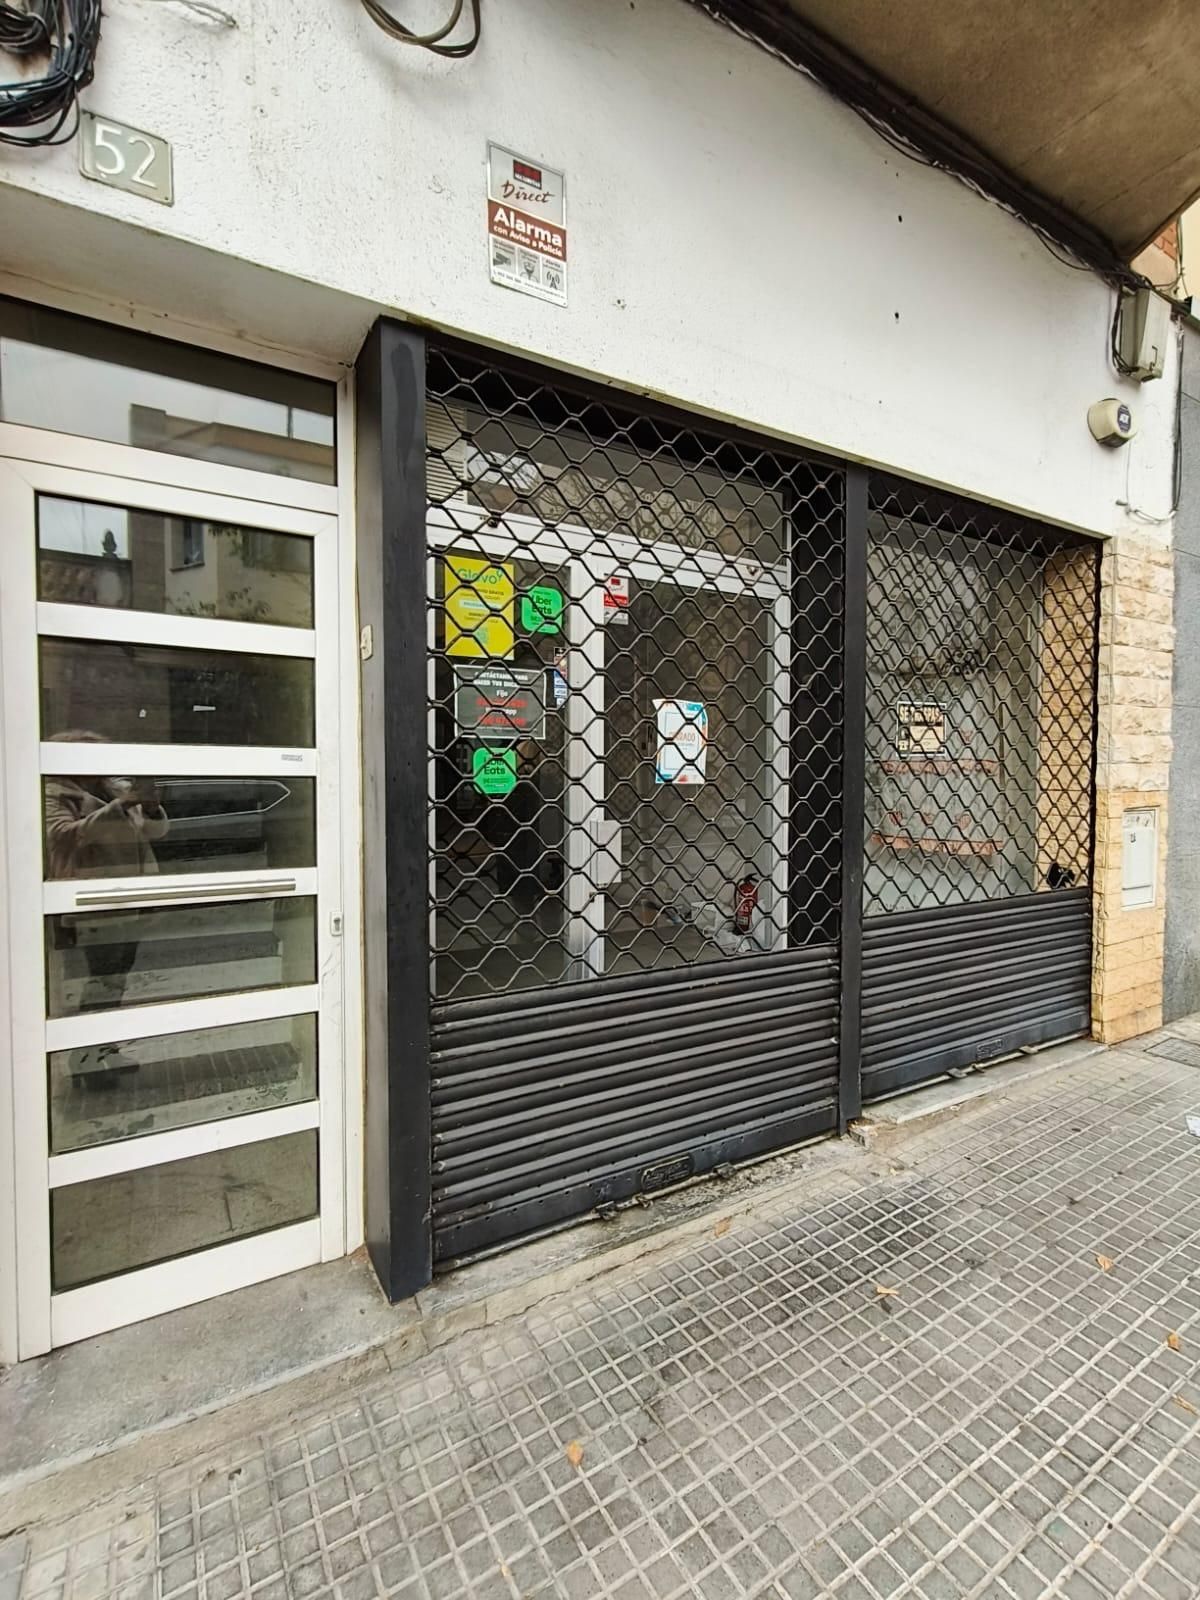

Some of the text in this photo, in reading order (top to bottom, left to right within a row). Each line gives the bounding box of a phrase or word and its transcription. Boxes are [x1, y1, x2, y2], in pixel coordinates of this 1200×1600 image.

[95, 122, 158, 190] 52
[501, 179, 555, 204] Direct
[493, 207, 563, 248] Alarma
[493, 225, 508, 236] con
[509, 229, 530, 245] Aviso
[484, 765, 506, 775] Eats
